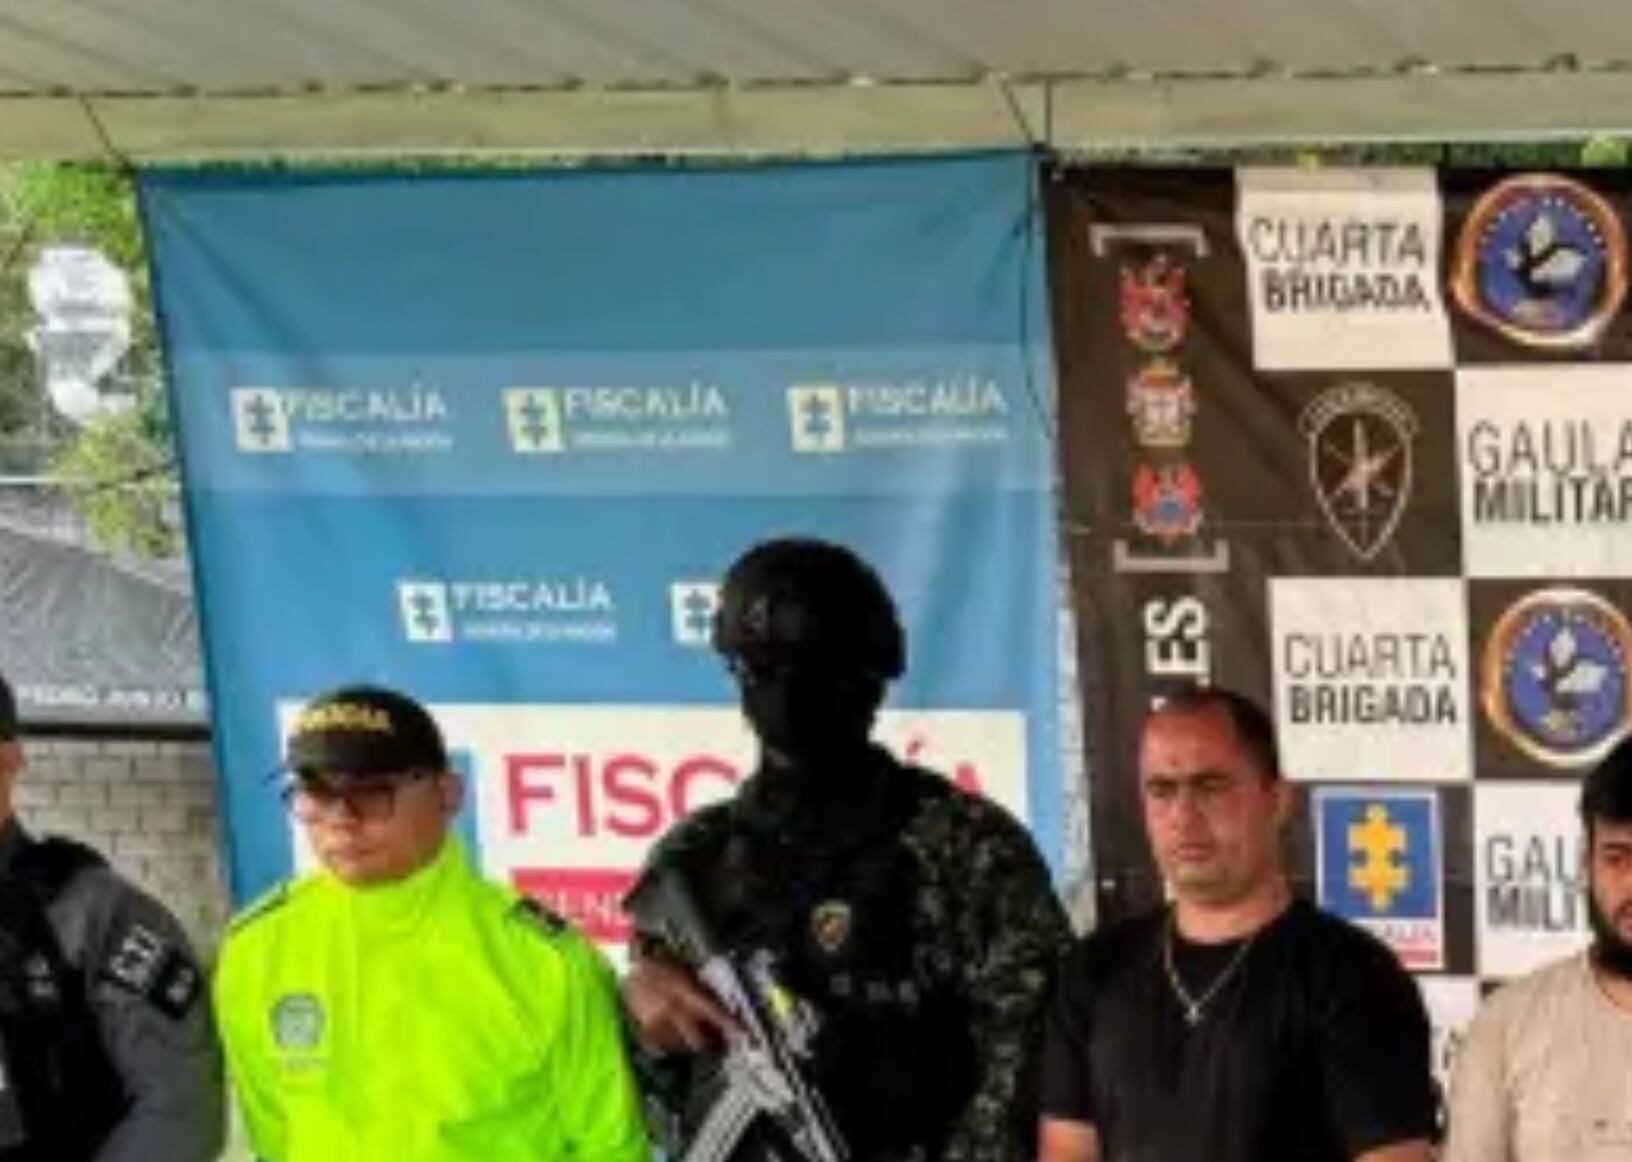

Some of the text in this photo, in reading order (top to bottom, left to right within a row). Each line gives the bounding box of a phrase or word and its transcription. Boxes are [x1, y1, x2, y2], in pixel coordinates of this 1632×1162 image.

[1248, 217, 1426, 265] CUARTA
[1263, 269, 1431, 312] BRIGADA
[1284, 634, 1456, 678] CUARTA
[1290, 685, 1457, 724] BRIGADA
[1487, 886, 1575, 930] MILI
